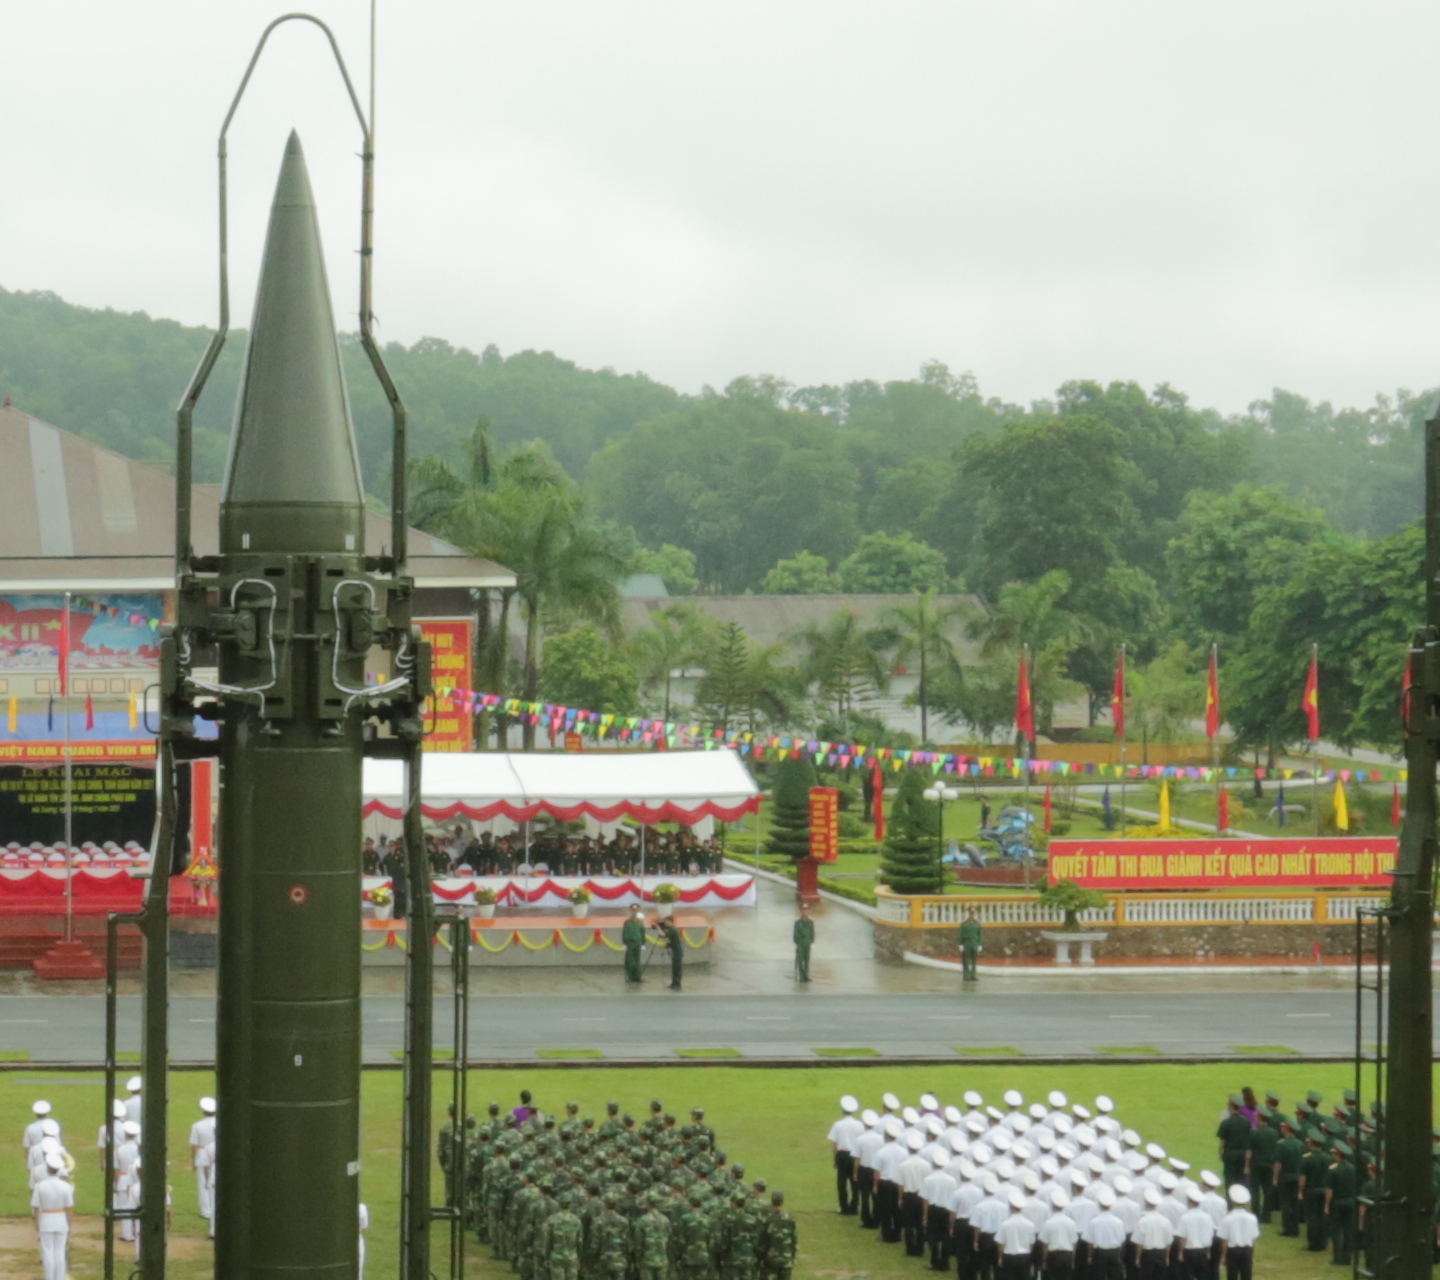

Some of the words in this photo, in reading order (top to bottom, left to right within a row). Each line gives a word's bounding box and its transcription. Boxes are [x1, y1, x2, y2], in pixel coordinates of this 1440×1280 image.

[27, 746, 57, 756] NAM
[106, 745, 137, 755] VINH
[1052, 848, 1089, 880] QUYẾT
[1091, 850, 1117, 878] TÂM
[1119, 855, 1138, 877] THI
[1140, 855, 1164, 877] ĐUA
[1167, 850, 1203, 877] GIÀNH
[1205, 847, 1227, 877] KẾT
[1229, 845, 1253, 879] QUẢ
[1255, 853, 1279, 876] CAO
[1281, 846, 1312, 876] NHẤT
[1314, 853, 1352, 876] TRONG
[1354, 848, 1374, 880] HỘI
